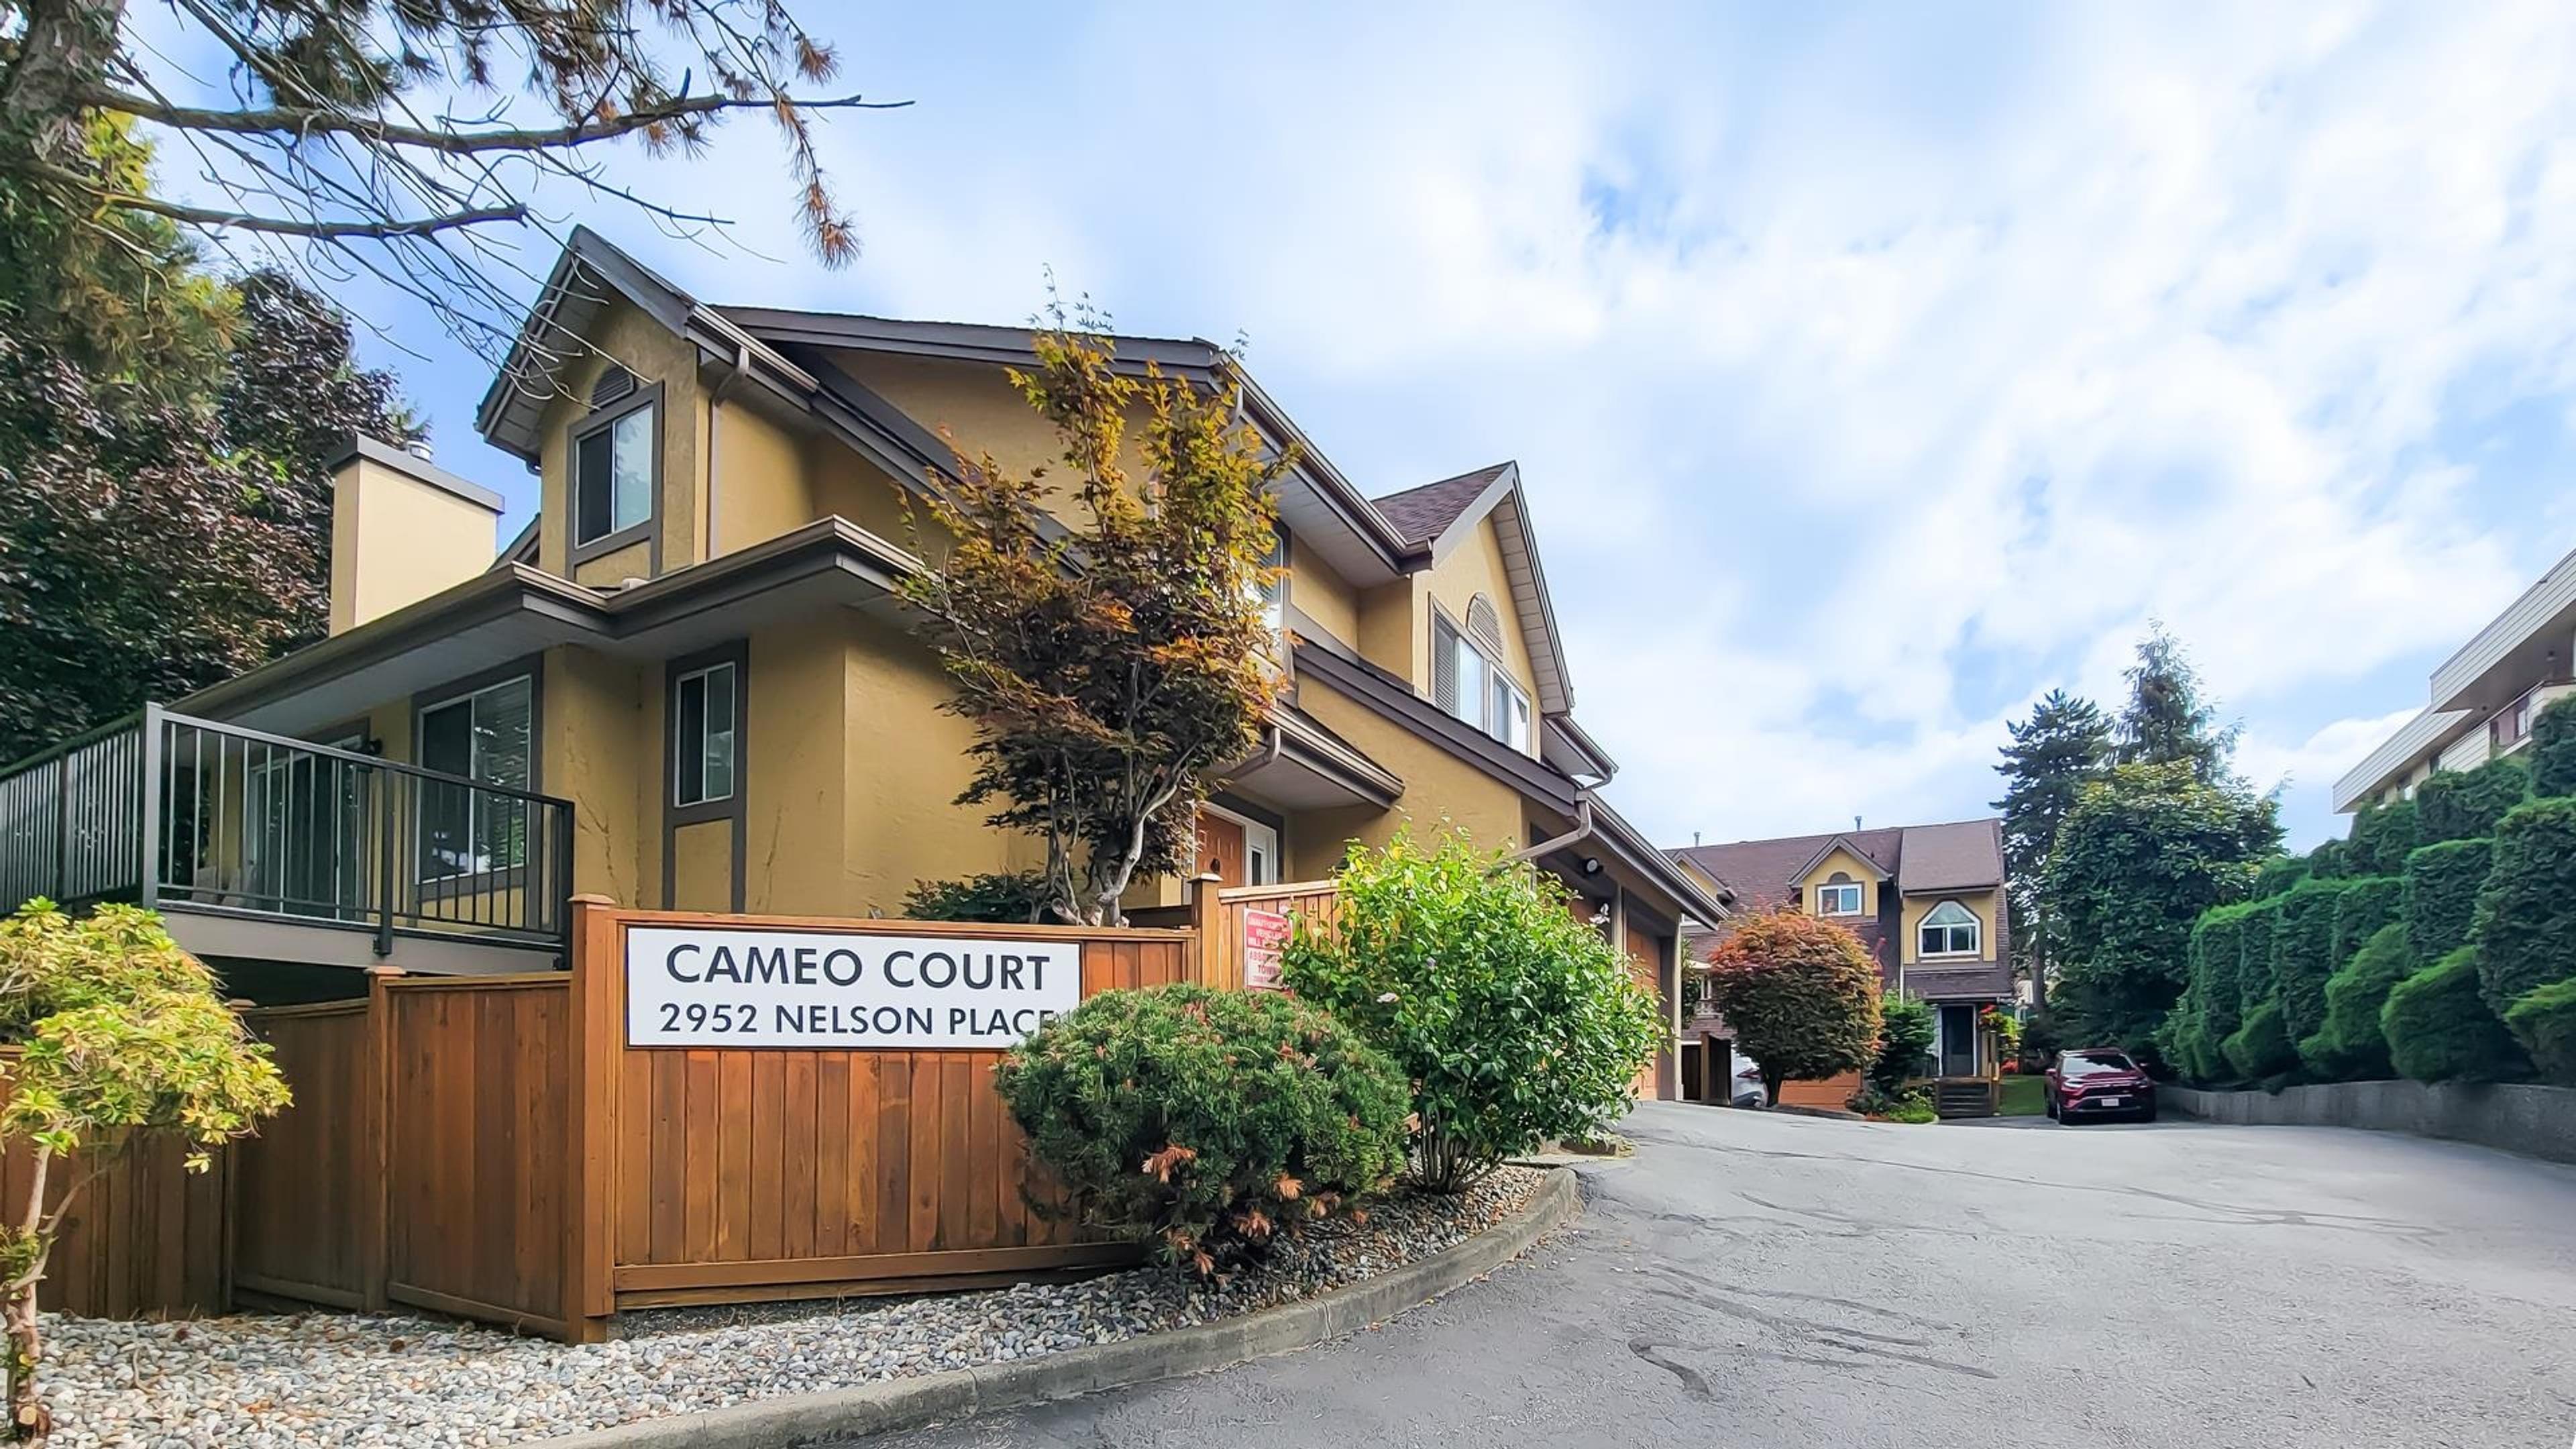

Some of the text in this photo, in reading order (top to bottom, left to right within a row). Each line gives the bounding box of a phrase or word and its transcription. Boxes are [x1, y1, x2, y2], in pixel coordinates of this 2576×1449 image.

[667, 945, 1049, 989] CAMEO COURT
[661, 1004, 757, 1032] 2952
[777, 1006, 932, 1034] NELSON
